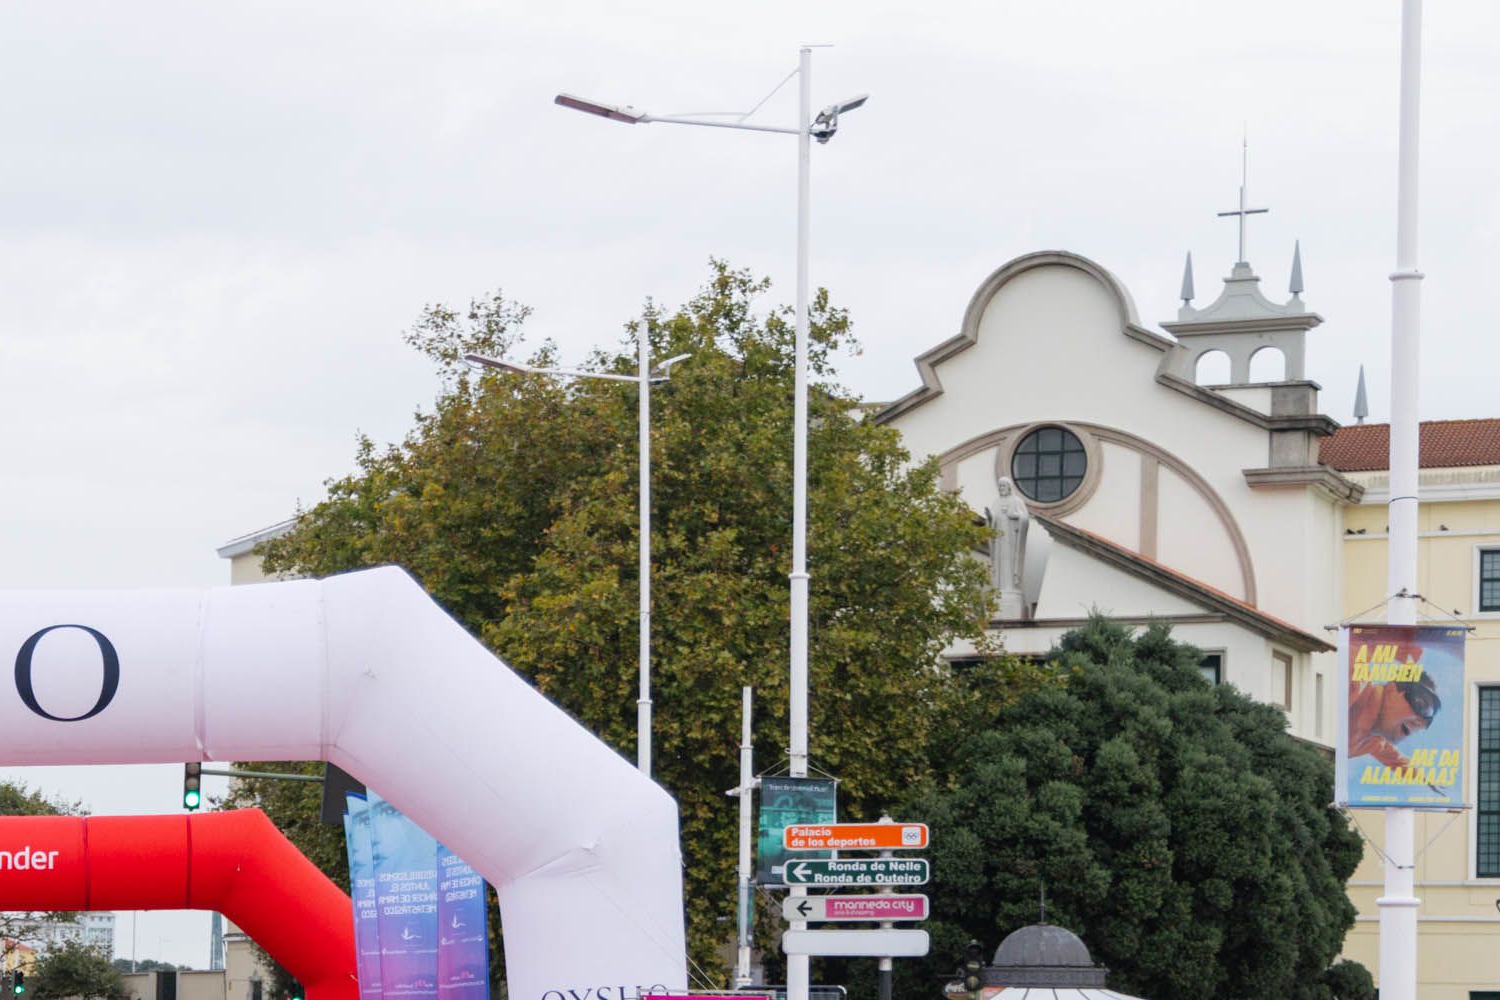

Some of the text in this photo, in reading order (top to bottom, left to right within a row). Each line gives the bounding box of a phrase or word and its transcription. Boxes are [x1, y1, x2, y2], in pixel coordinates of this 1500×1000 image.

[1410, 748, 1460, 767] ME DA
[791, 827, 832, 836] Palacio
[791, 837, 876, 849] de los deportes
[828, 862, 921, 871] Ronda de Nelle
[814, 873, 921, 883] Ronda de Outeiro
[834, 900, 914, 912] marineda city
